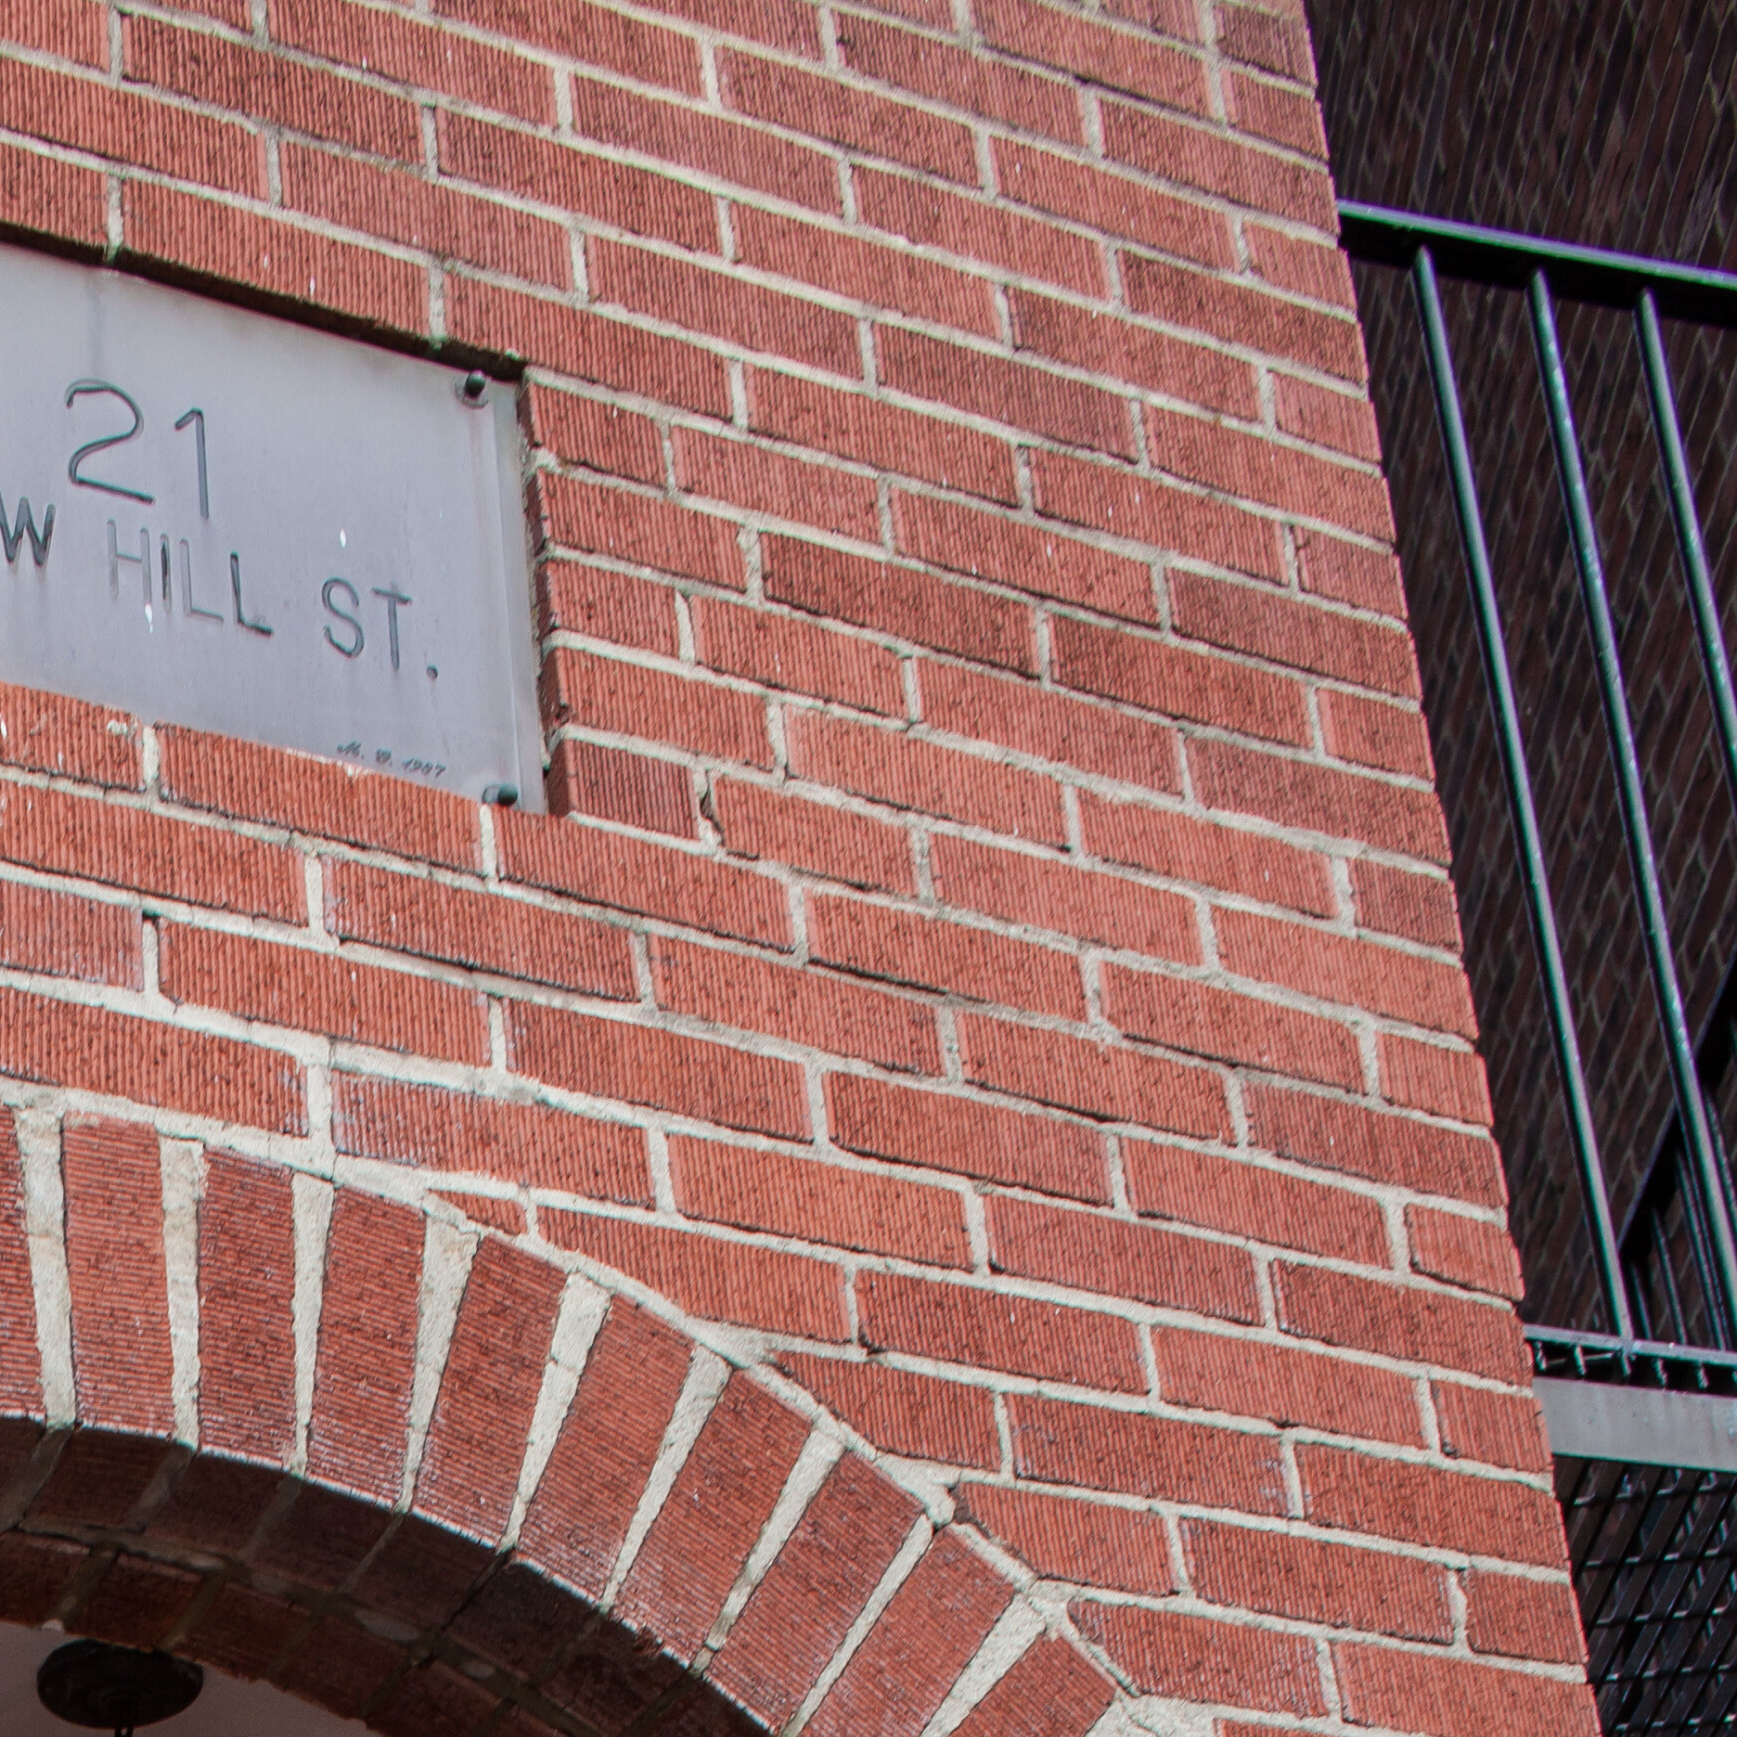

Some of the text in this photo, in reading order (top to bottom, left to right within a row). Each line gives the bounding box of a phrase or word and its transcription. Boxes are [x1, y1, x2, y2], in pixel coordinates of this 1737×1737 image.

[66, 378, 211, 518] 21
[106, 519, 274, 637] HILL
[321, 577, 438, 680] ST.
